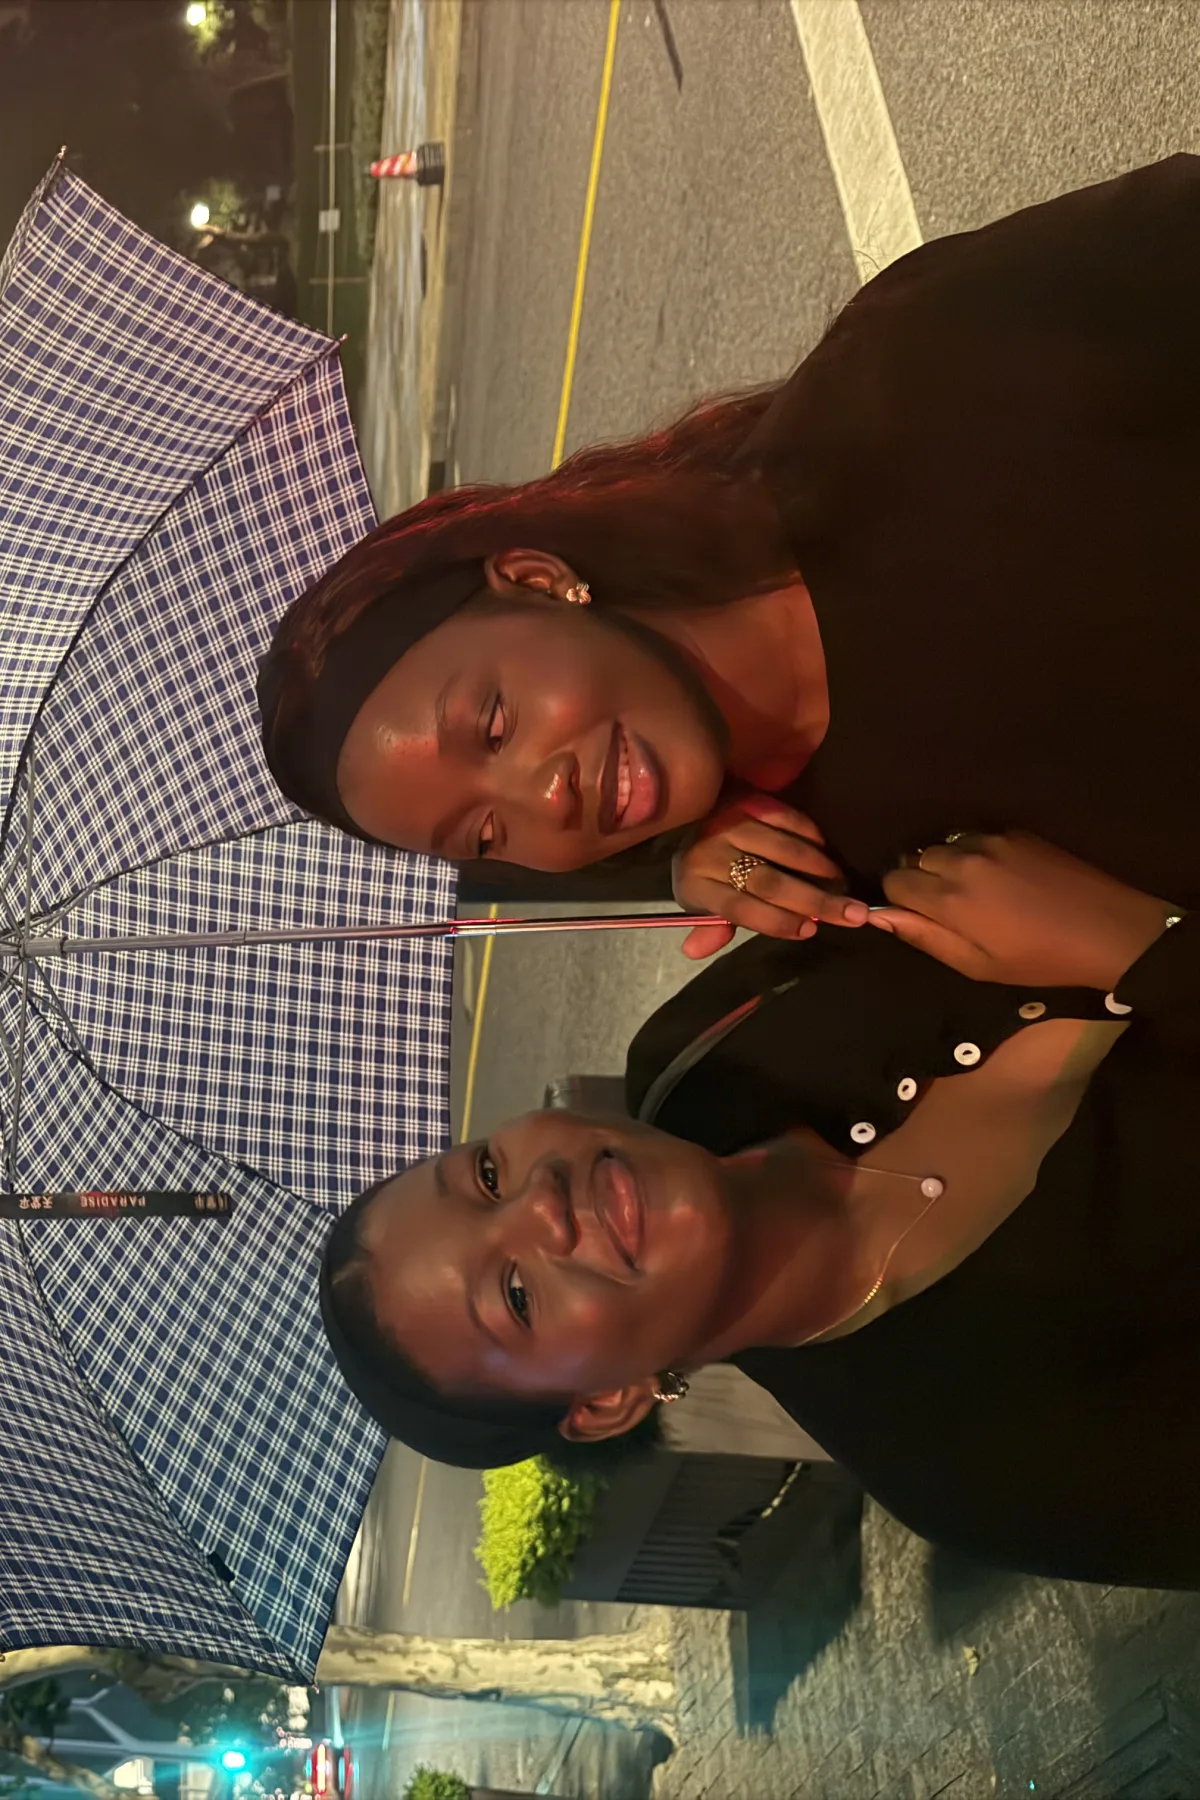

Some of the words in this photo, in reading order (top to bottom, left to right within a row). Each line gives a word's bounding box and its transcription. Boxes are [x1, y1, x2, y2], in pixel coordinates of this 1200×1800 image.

[19, 1195, 53, 1209] 天堂伞
[80, 1195, 146, 1208] PARADISE
